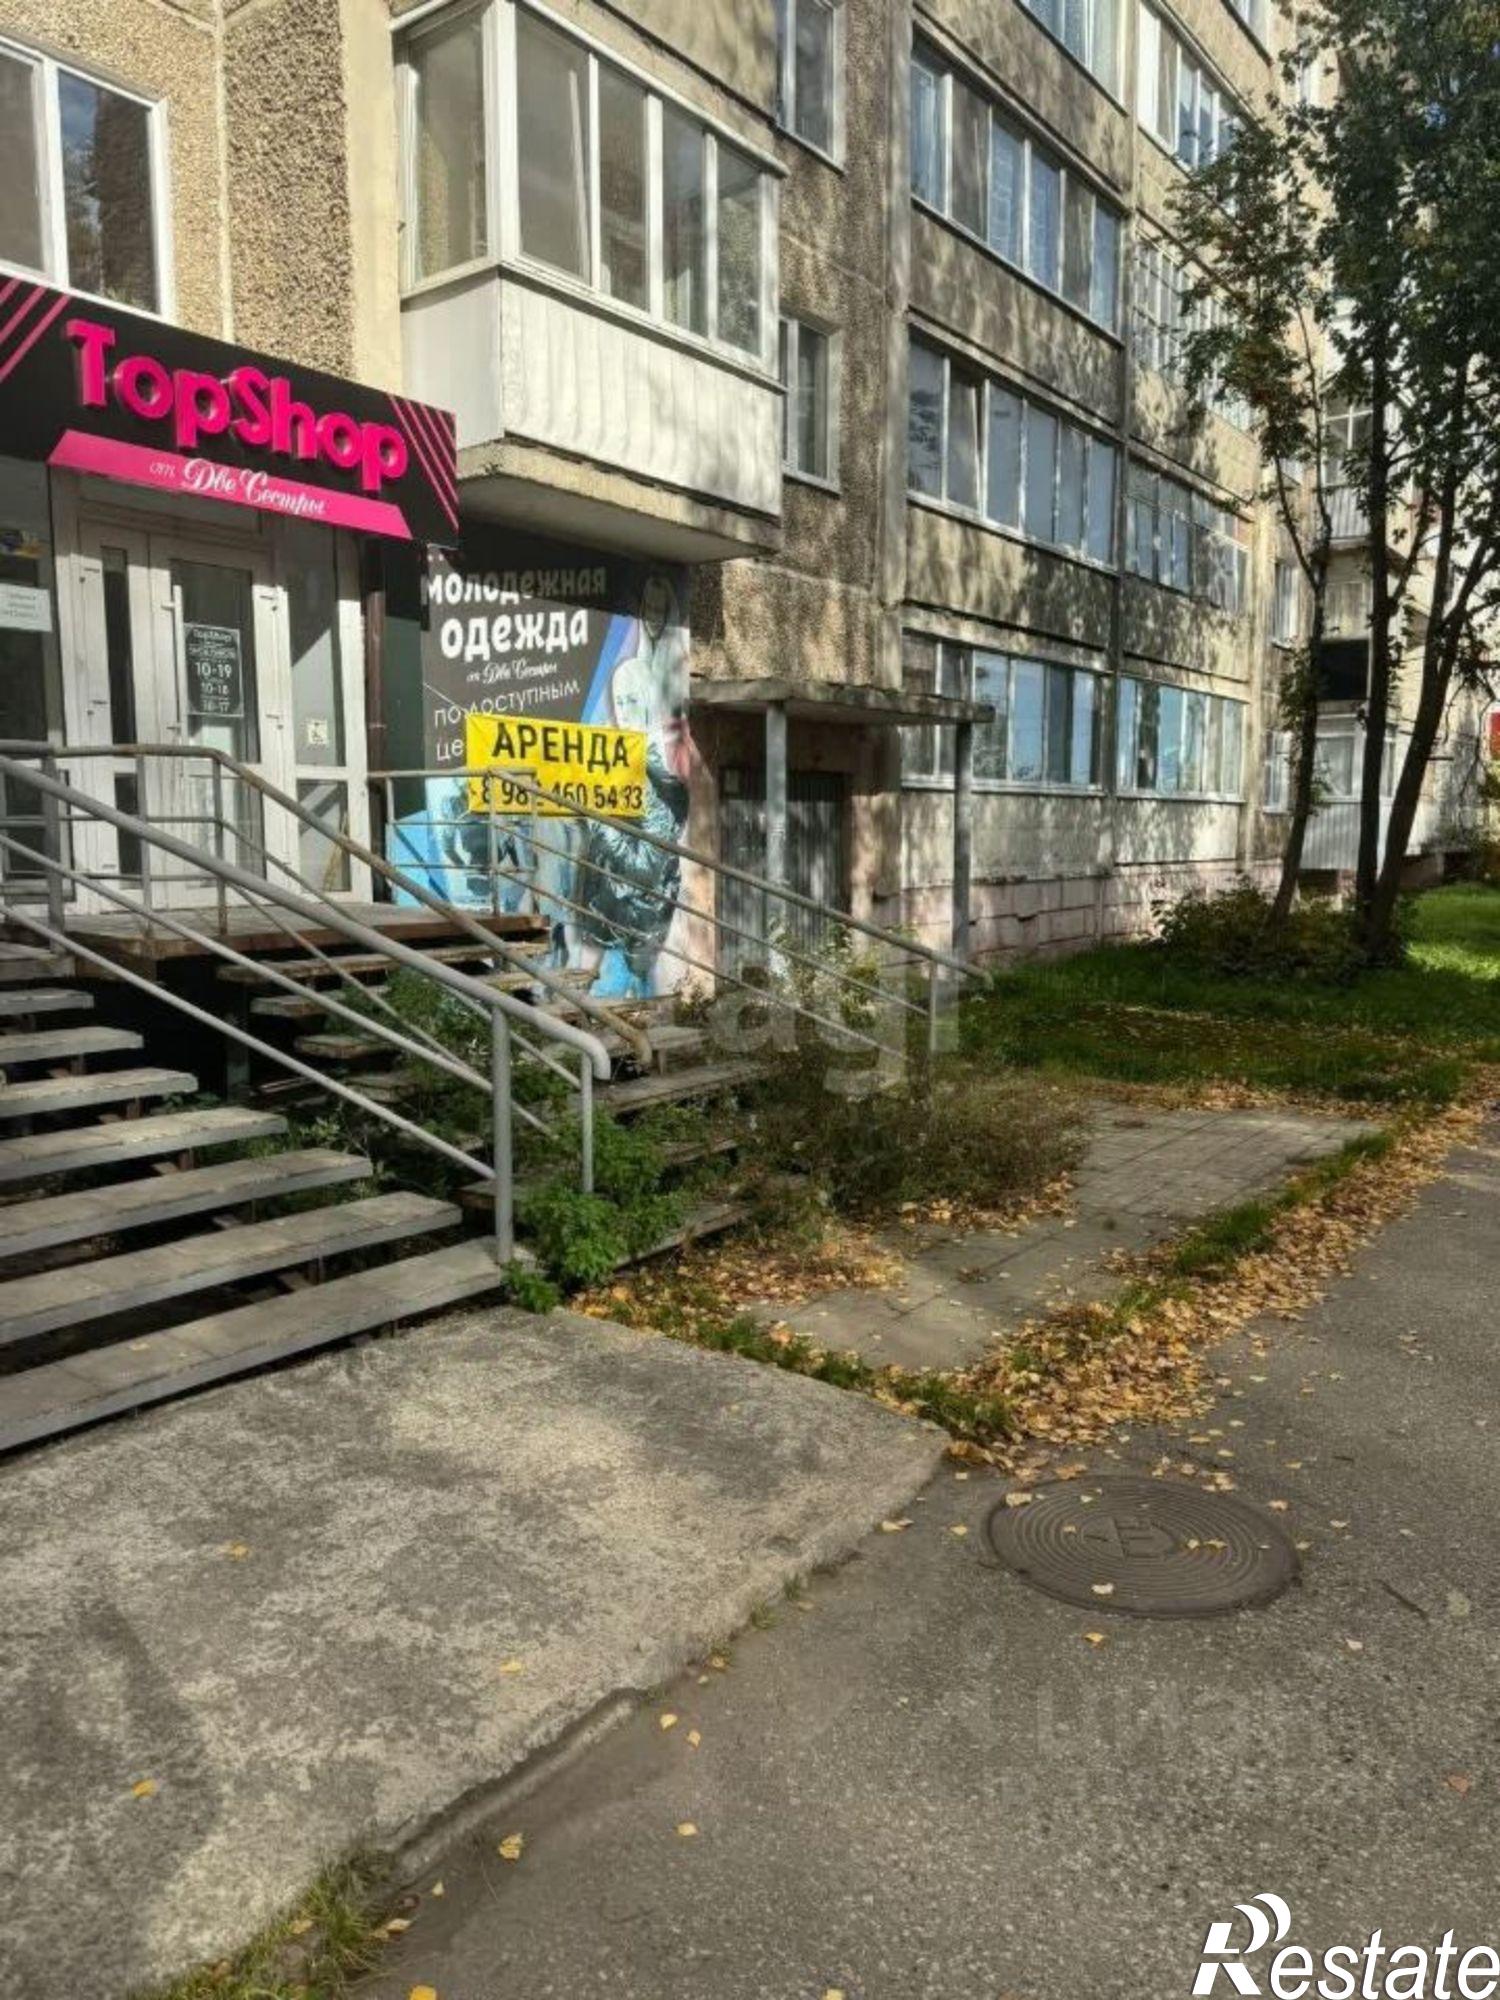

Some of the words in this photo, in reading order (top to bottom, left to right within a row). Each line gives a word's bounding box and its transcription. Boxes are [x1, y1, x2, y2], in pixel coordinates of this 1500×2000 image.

[64, 319, 408, 494] TopShop
[440, 608, 588, 663] одежда
[195, 662, 232, 678] 10-19
[491, 721, 630, 775] АРЕНДА
[594, 784, 617, 810] 54
